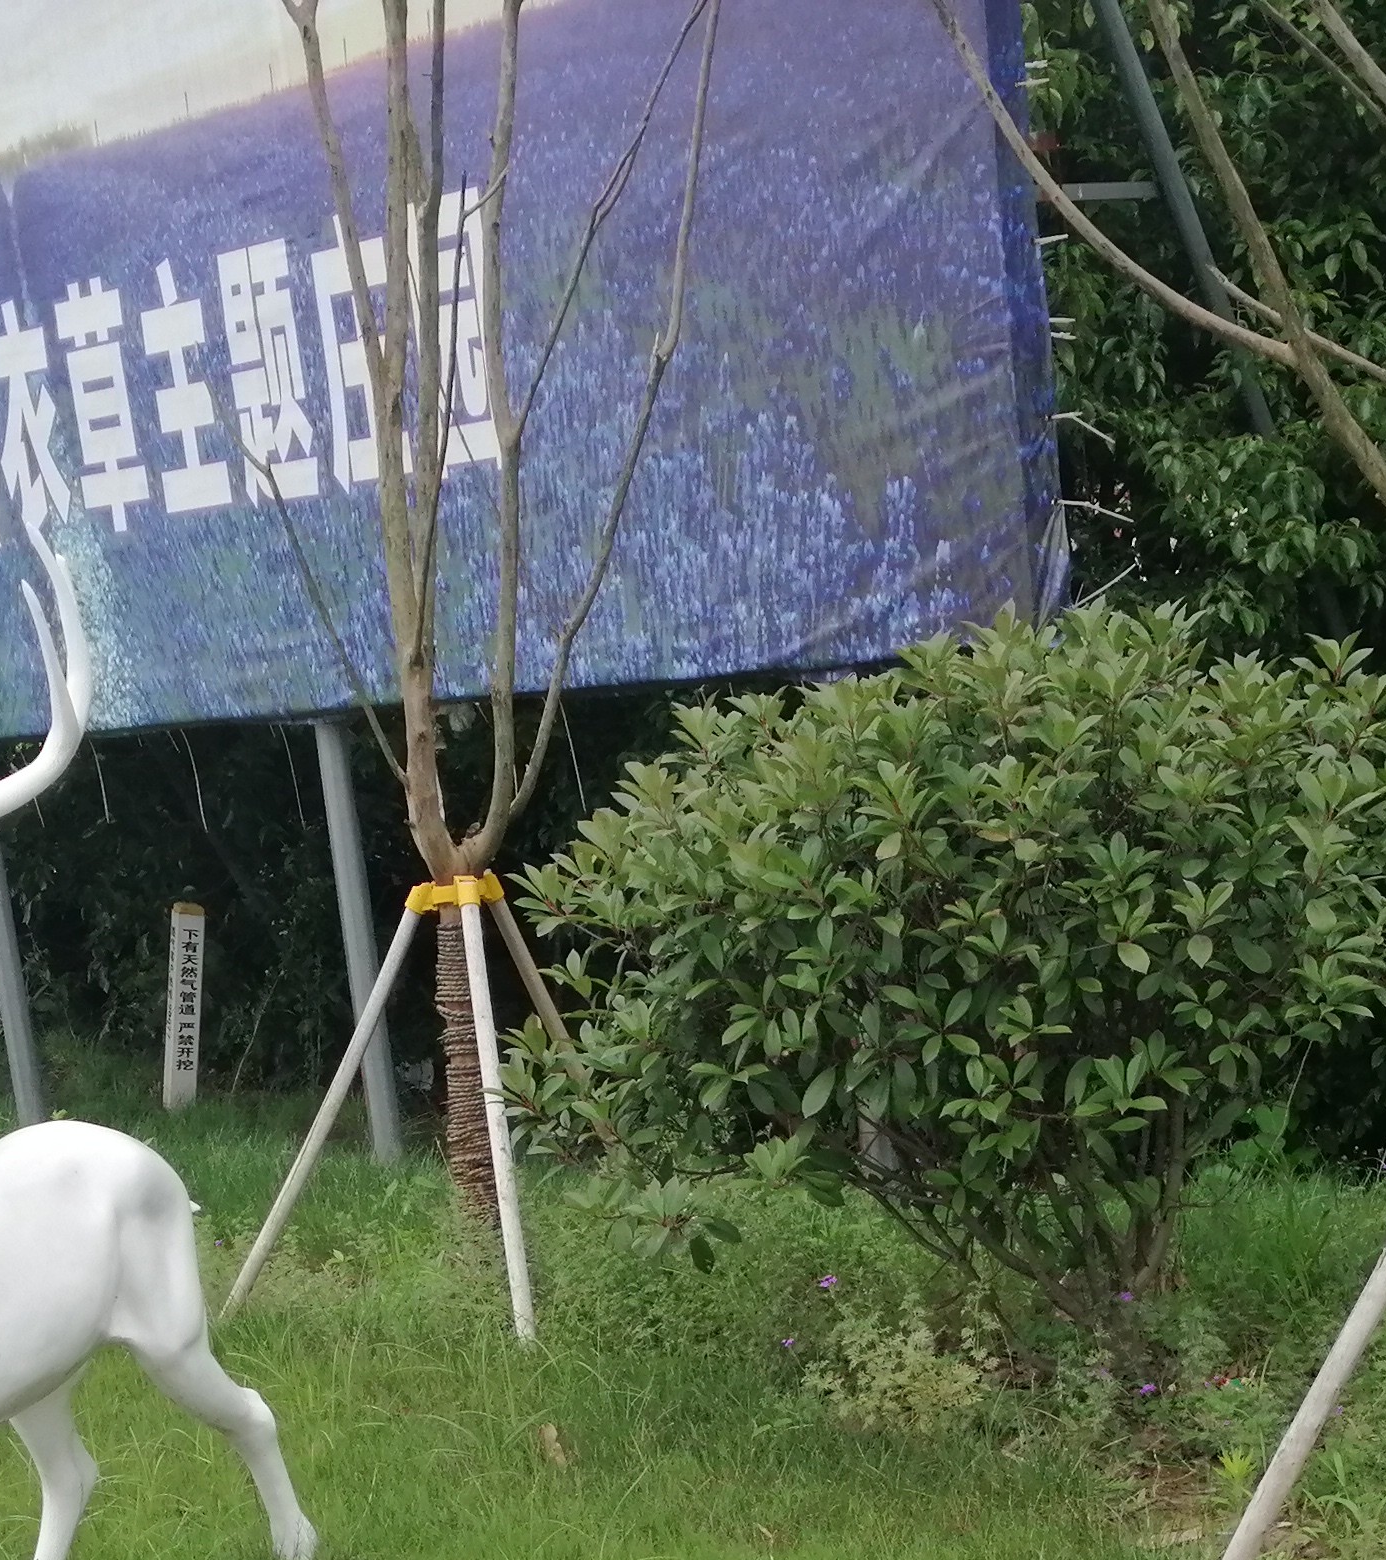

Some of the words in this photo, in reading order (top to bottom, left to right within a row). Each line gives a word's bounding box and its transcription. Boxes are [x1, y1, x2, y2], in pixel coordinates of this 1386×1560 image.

[179, 929, 200, 1015] 下有天然气管道
[176, 1022, 195, 1071] 严禁开挖
